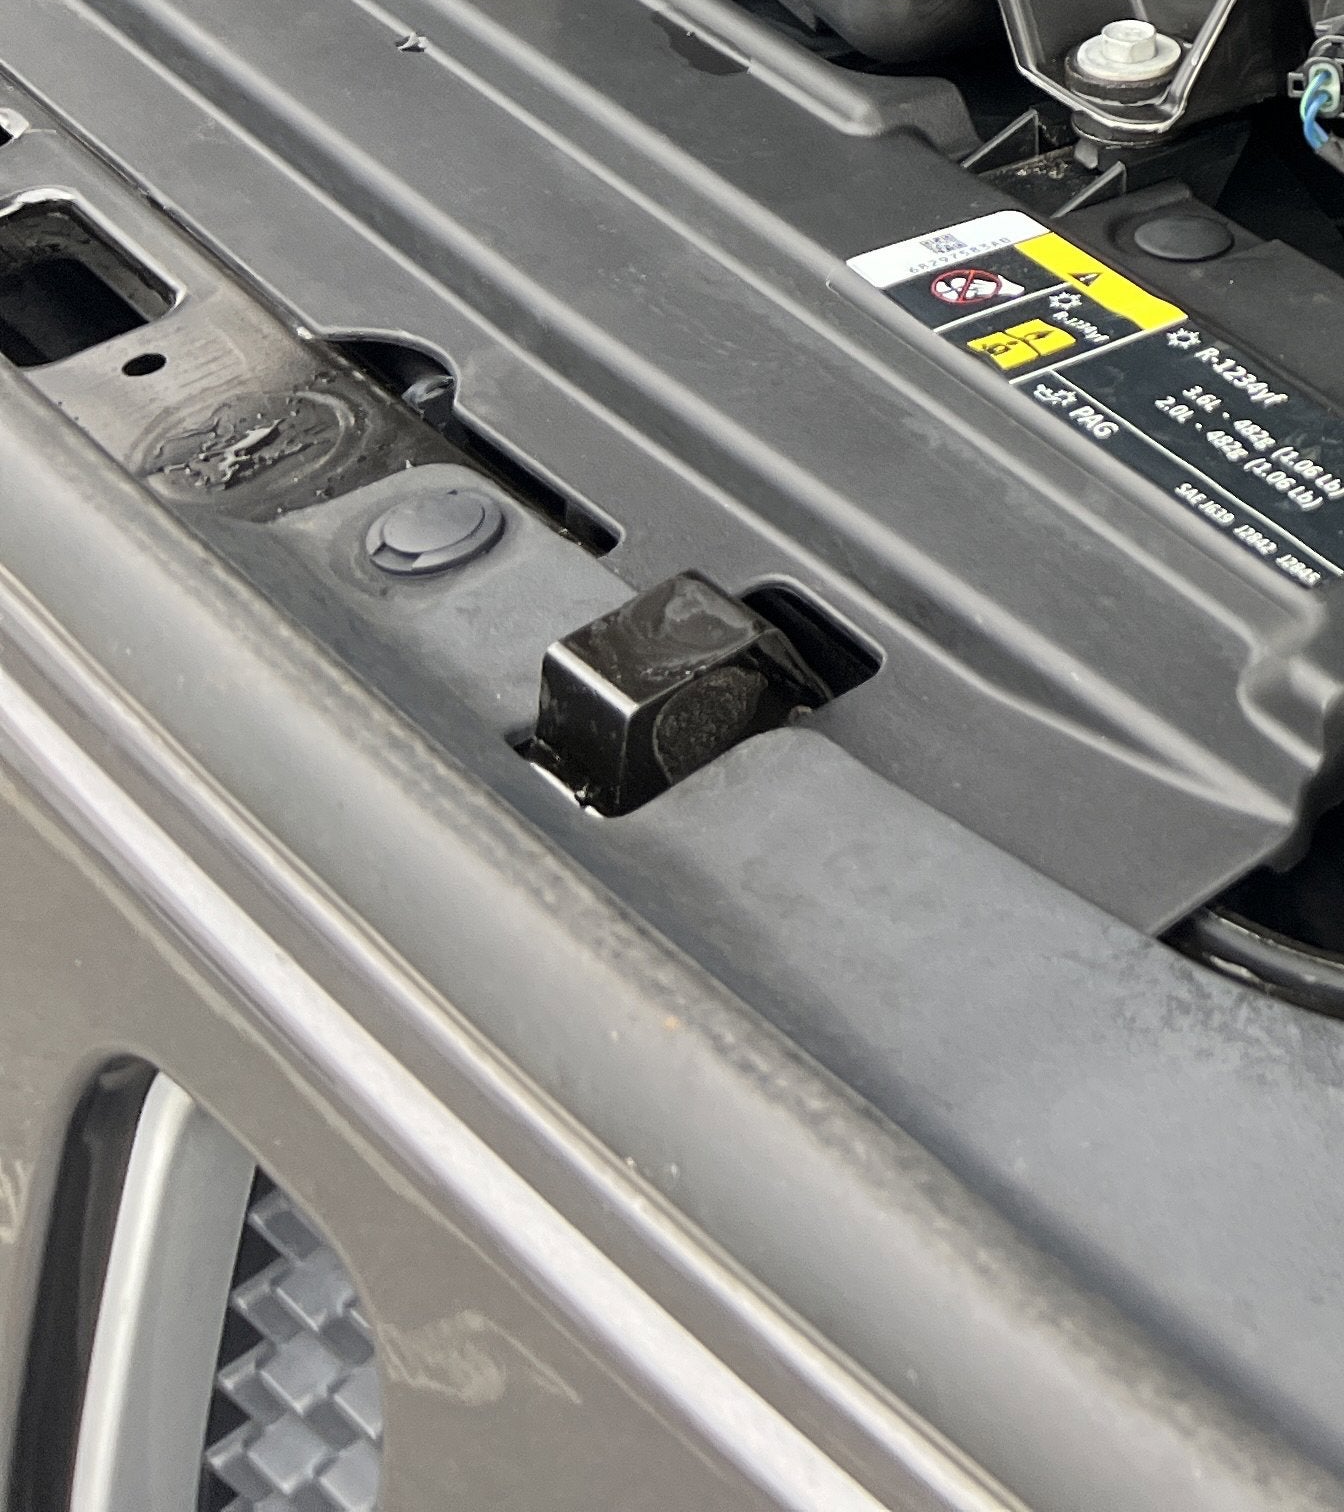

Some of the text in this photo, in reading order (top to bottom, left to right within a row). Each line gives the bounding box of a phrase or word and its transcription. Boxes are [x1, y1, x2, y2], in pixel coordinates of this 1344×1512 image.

[1194, 346, 1290, 408] R-1234yf
[1068, 405, 1120, 440] PAG
[1153, 395, 1195, 424] 2.0L
[1206, 429, 1249, 463] 482g
[1243, 457, 1297, 494] (1.06
[1182, 385, 1222, 414] 3.6L
[1232, 418, 1277, 452] 482g
[1270, 445, 1324, 480] (1.06
[1174, 482, 1207, 510] SAE
